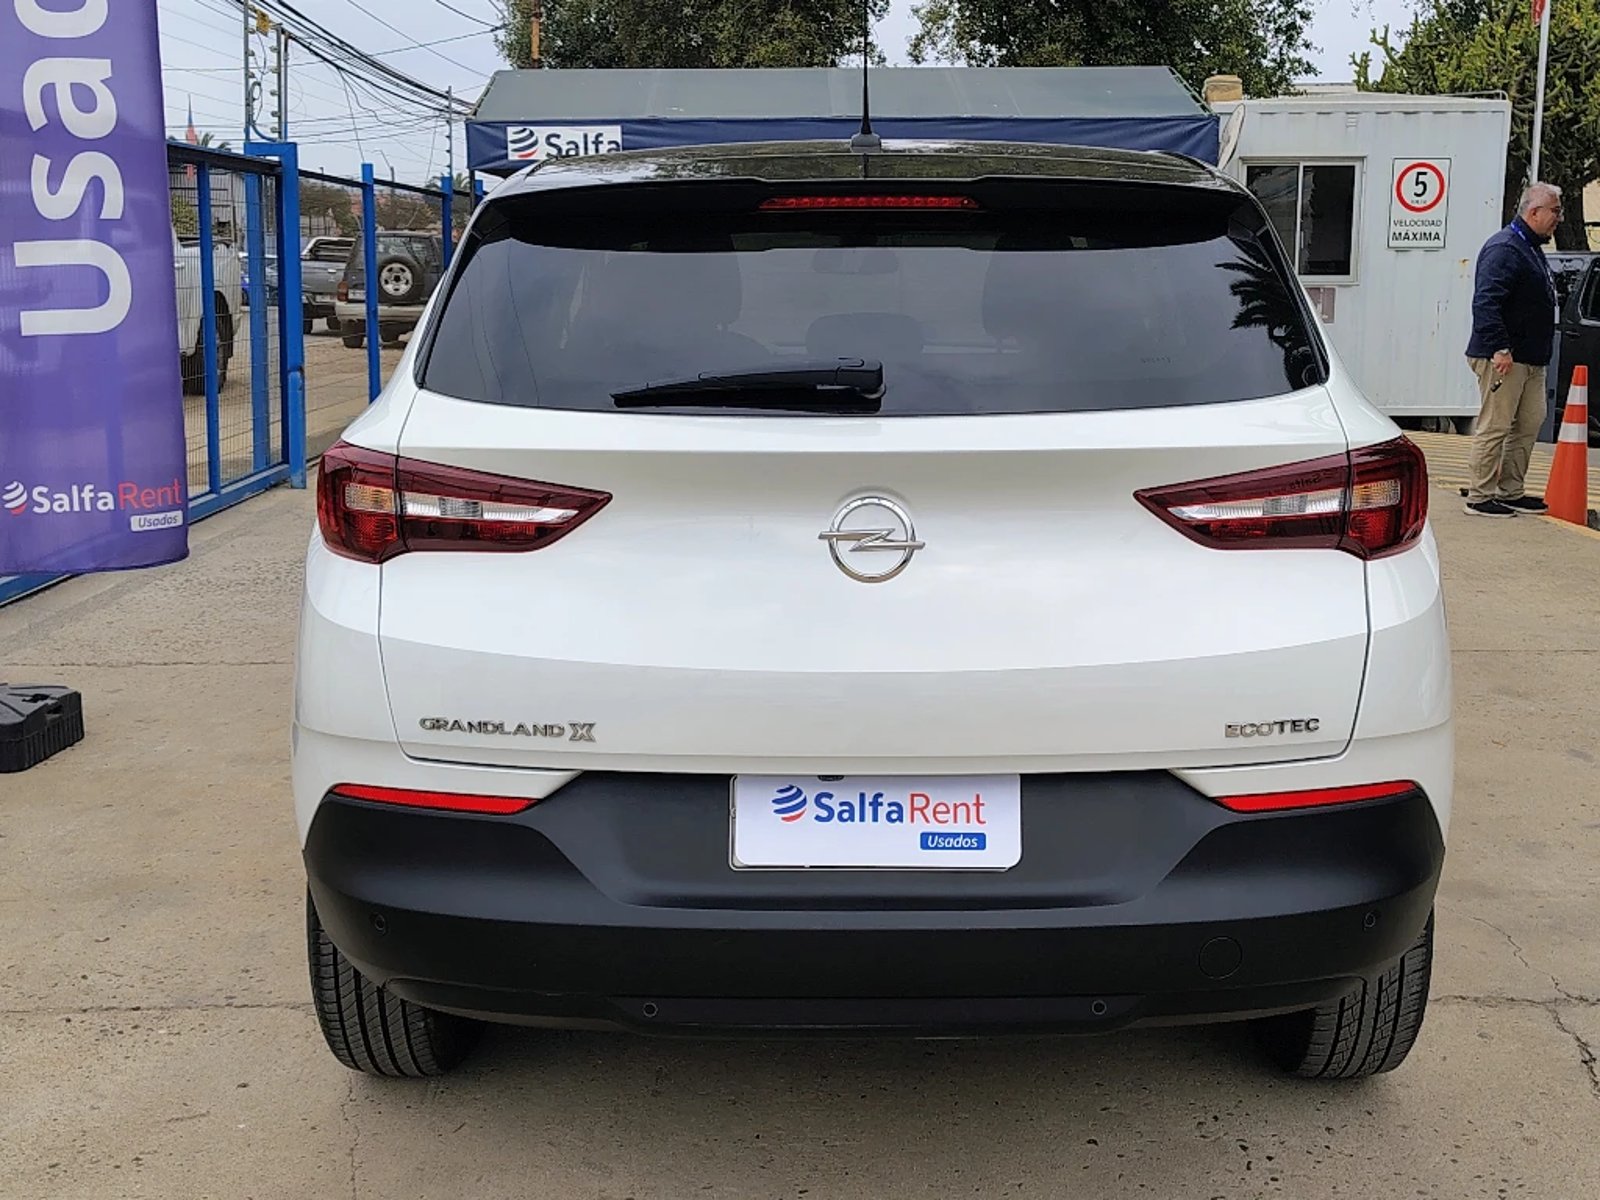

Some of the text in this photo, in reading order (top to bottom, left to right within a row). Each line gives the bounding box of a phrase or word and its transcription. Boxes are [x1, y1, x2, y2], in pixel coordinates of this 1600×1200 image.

[544, 132, 621, 160] Salfa
[1413, 171, 1428, 198] 5
[1393, 219, 1443, 228] VELOCIDAD
[1391, 229, 1441, 242] MÁXIMA
[138, 514, 178, 529] Usados
[419, 717, 596, 742] GRANDLAND X
[1224, 718, 1320, 738] ECOTEC
[927, 833, 978, 848] Usados
